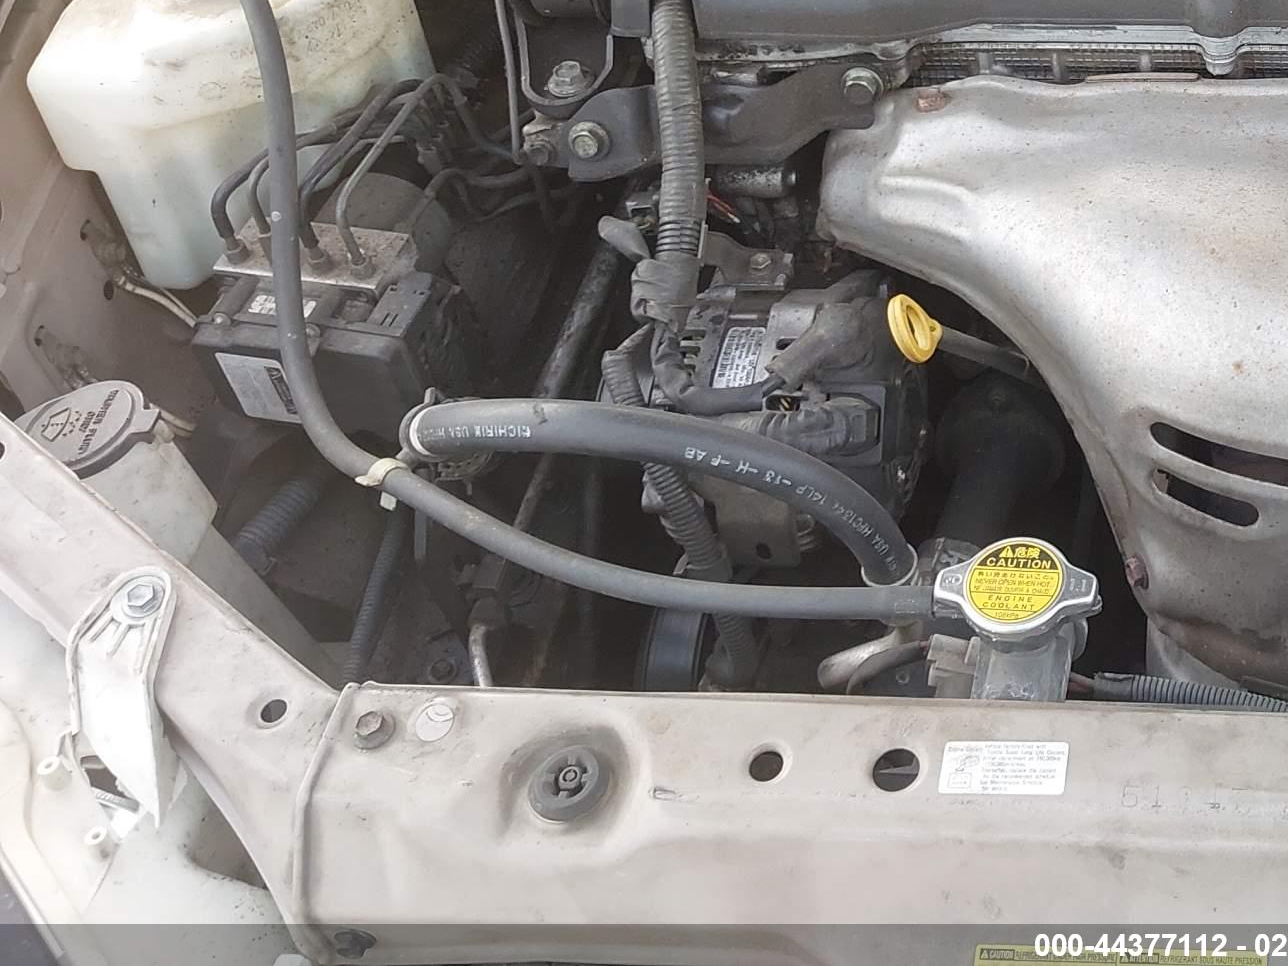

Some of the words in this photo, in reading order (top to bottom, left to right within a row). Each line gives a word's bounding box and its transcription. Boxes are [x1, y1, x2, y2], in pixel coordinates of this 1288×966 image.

[684, 446, 707, 462] AB
[987, 557, 1051, 569] CAUTION
[988, 594, 1033, 602] ENGINE
[982, 602, 1035, 610] COOLANT
